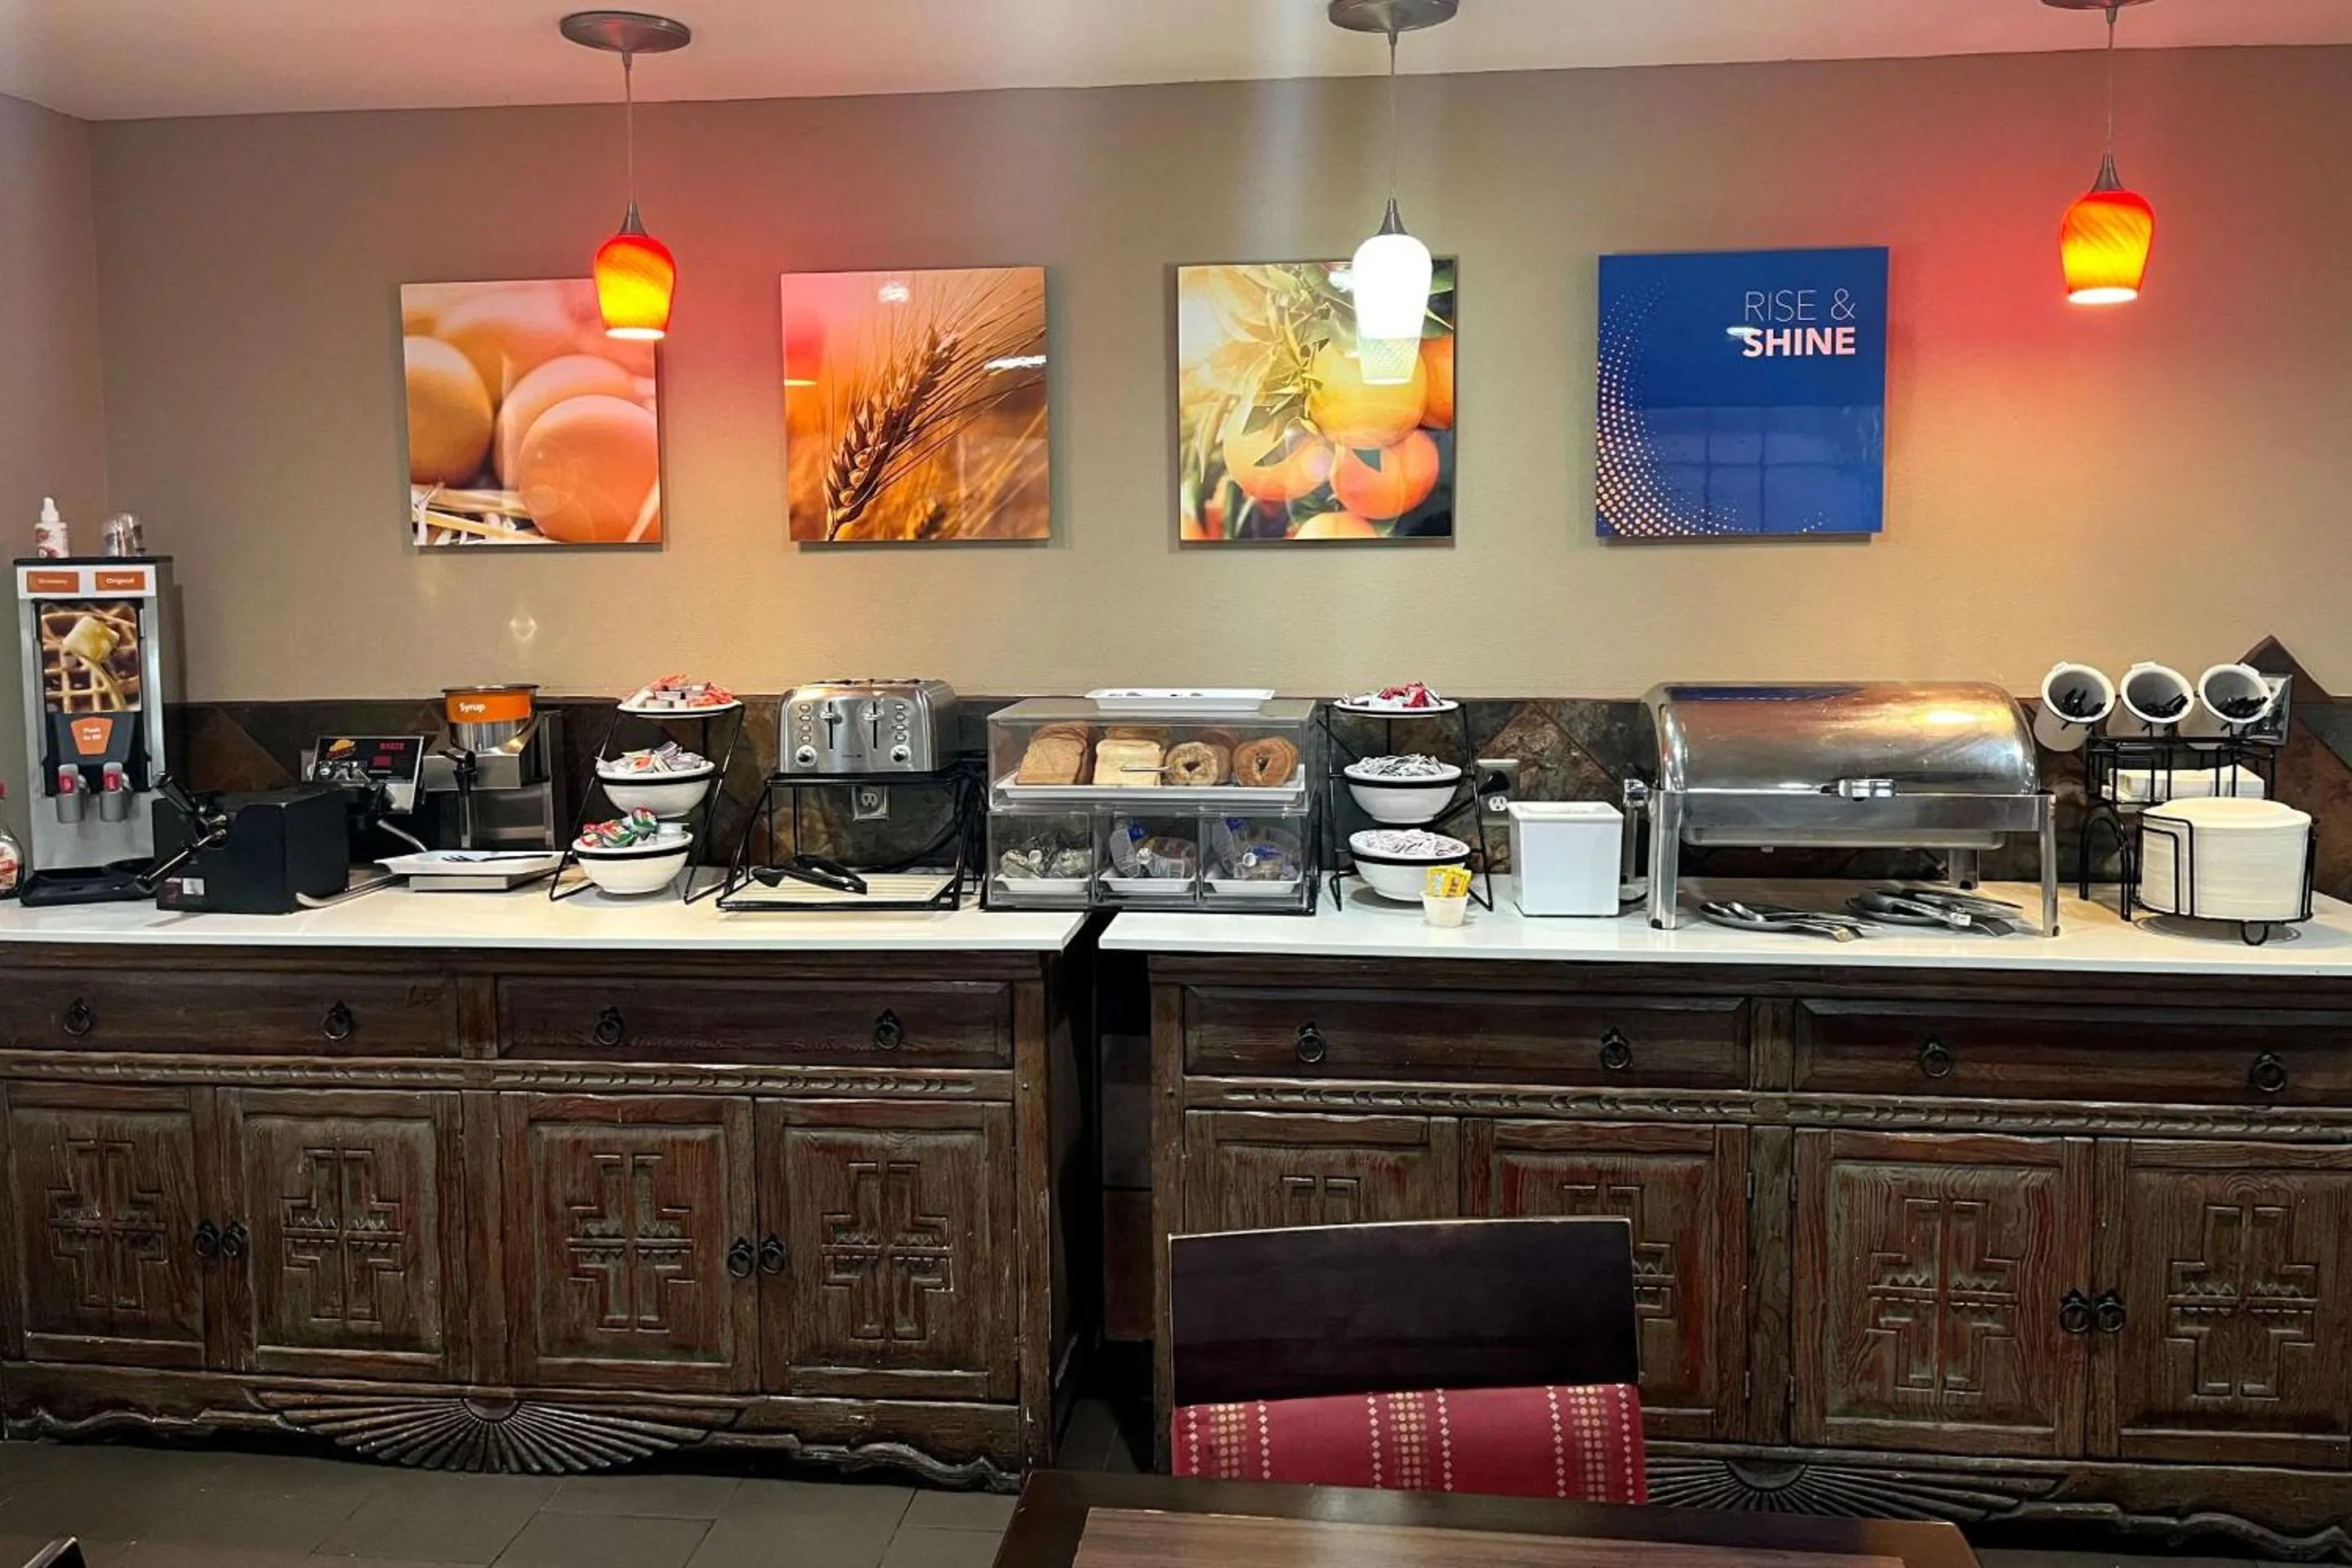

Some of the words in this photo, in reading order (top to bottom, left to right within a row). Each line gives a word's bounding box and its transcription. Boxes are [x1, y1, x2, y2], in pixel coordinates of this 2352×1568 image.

[1744, 289, 1817, 322] RISE
[1830, 287, 1856, 321] &
[1742, 327, 1856, 357] SHINE
[459, 702, 487, 713] Syrup
